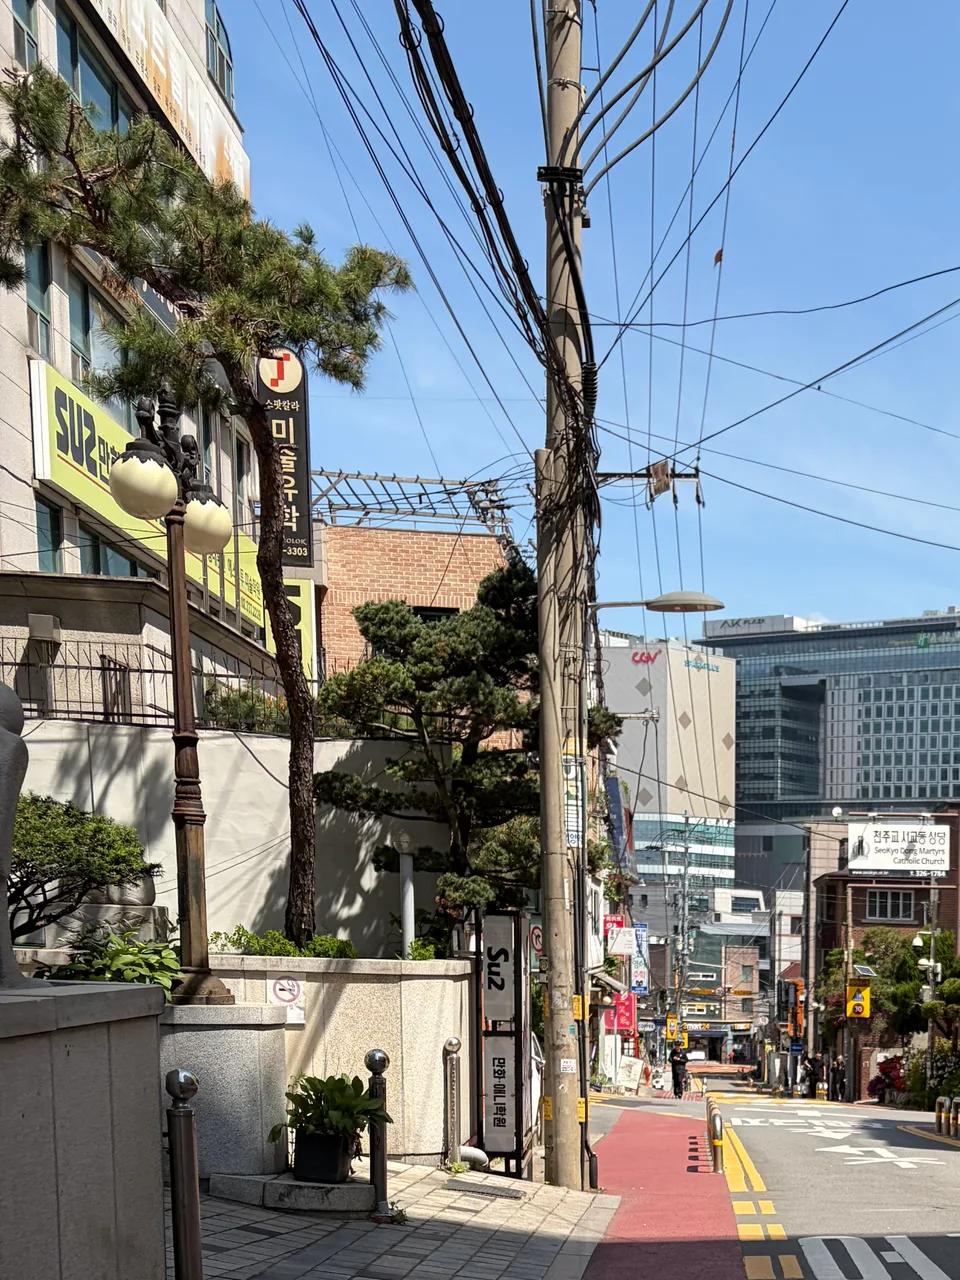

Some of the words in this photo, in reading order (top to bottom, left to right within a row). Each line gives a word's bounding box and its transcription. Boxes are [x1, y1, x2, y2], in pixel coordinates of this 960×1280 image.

[720, 618, 742, 628] AK
[631, 649, 662, 665] CGV
[921, 857, 945, 865] Church
